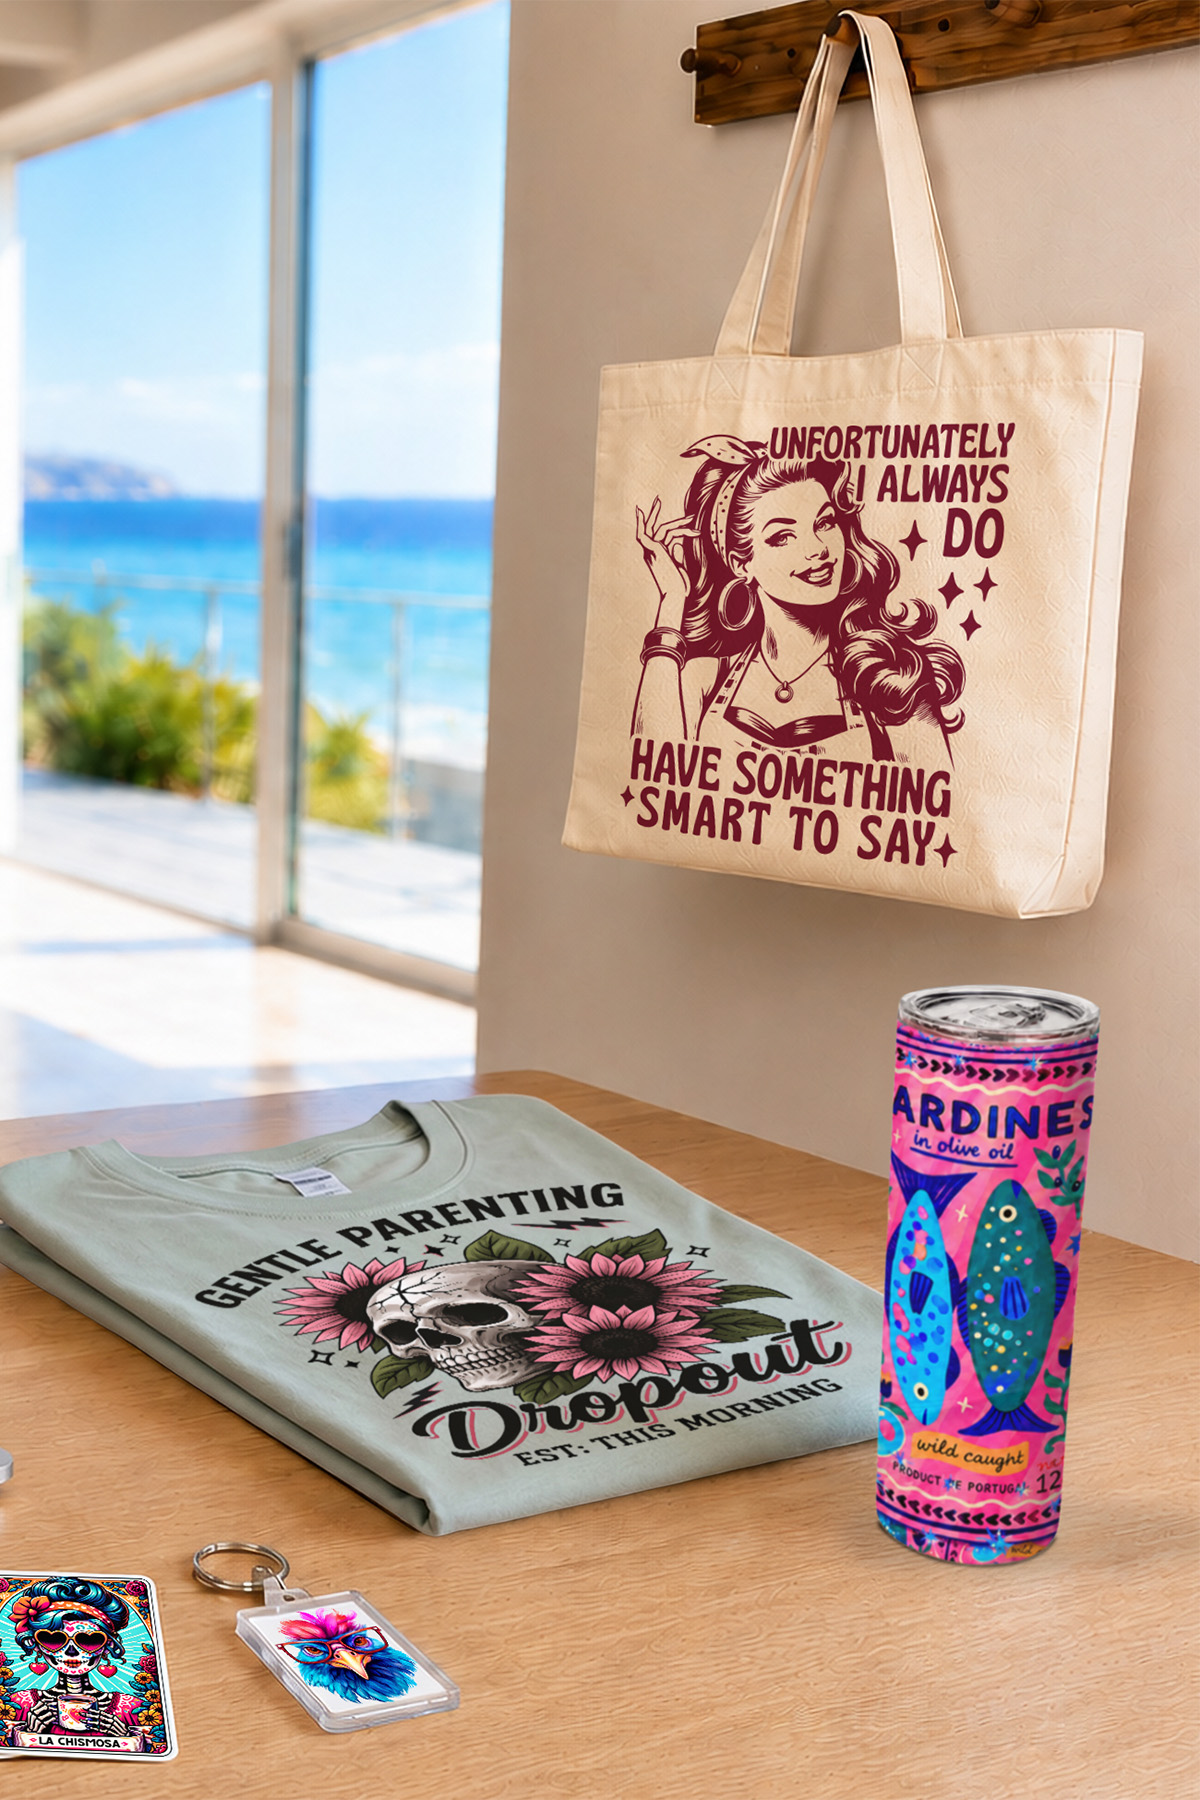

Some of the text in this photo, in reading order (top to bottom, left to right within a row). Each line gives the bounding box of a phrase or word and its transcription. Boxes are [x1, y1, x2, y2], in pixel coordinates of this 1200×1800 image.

[769, 423, 1015, 460] UNFORTUNATELY
[855, 464, 1010, 503] I ALWAYS
[944, 509, 1003, 558] DO
[630, 738, 951, 818] HAVE SOMETHING
[637, 787, 936, 866] SMART TO SAY
[914, 1130, 1014, 1159] in olive oil
[194, 1182, 625, 1309] GENTLE PARENTING
[412, 1319, 850, 1460] Dropout
[513, 1377, 844, 1467] EST: THIS MORNING
[917, 1439, 1024, 1473] wild caught
[893, 1460, 941, 1486] PRODUCT
[968, 1482, 1026, 1494] PORTUGA
[1036, 1470, 1061, 1494] 12
[38, 1736, 121, 1749] LA CHISMOSA
